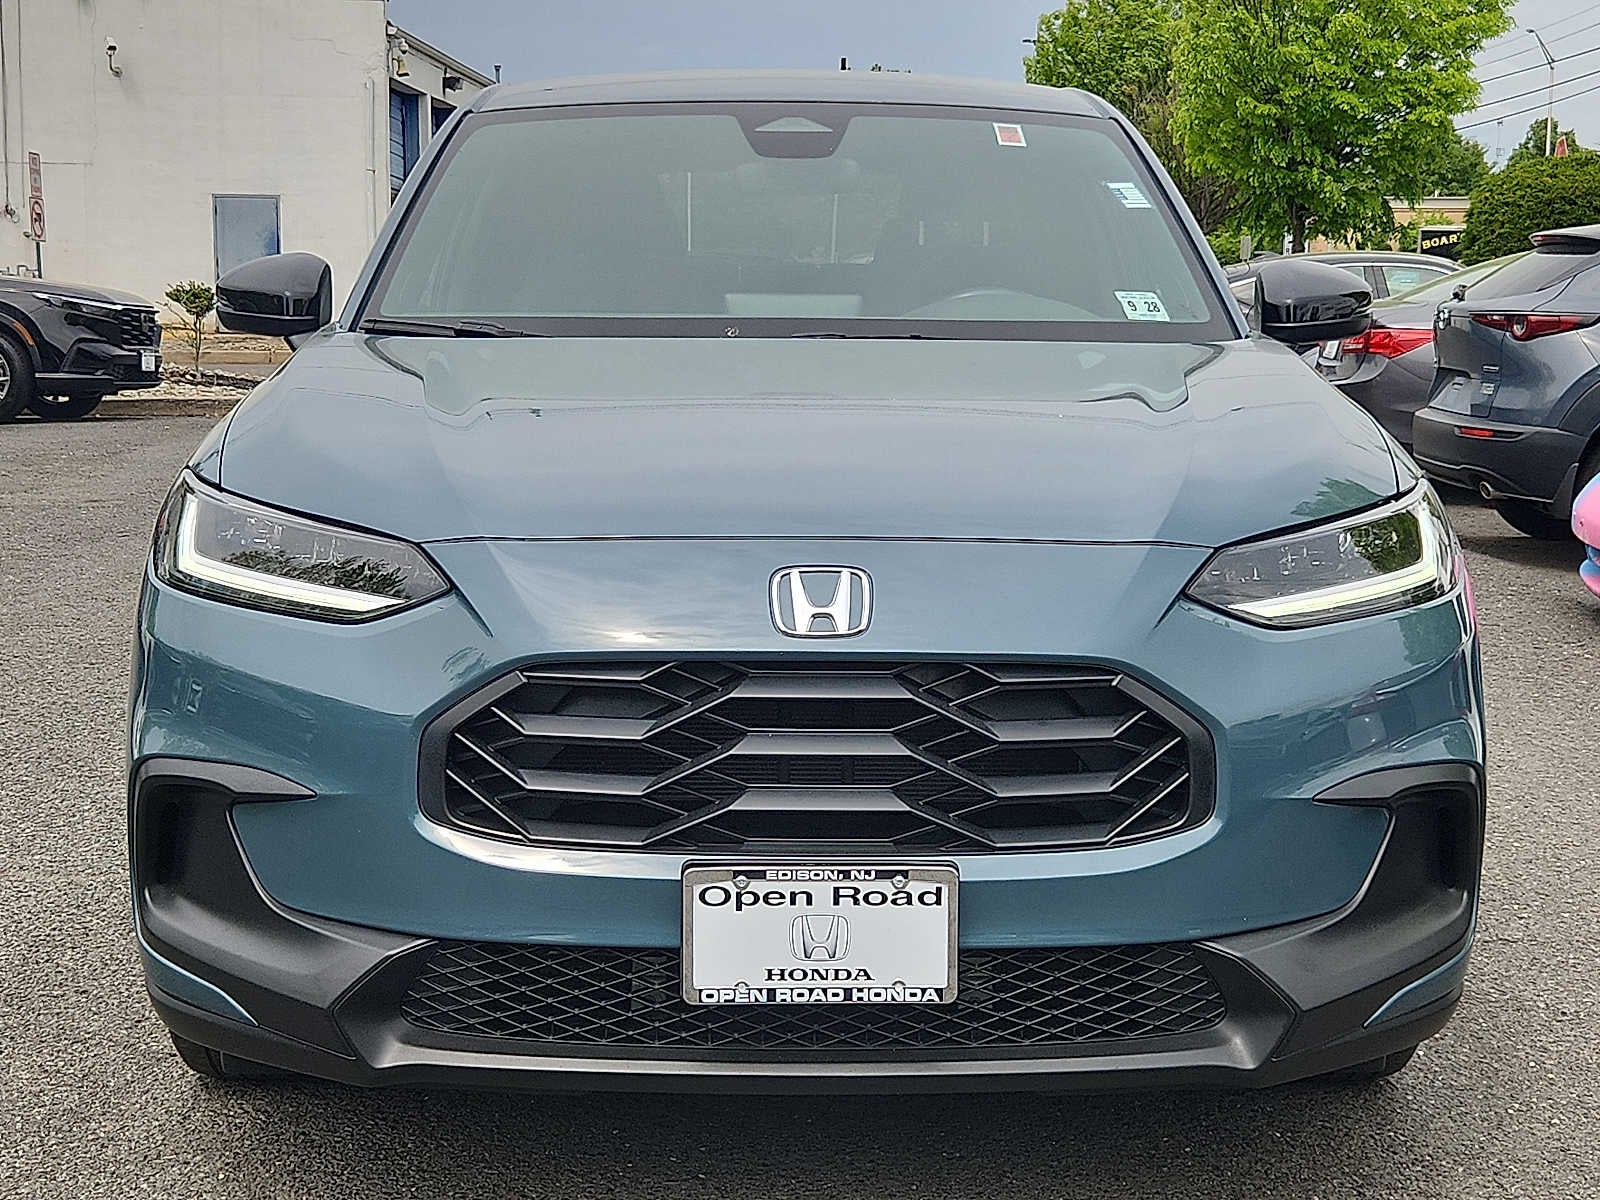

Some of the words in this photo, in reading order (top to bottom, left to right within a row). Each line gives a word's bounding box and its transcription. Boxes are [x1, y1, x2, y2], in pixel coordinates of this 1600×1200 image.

[1127, 300, 1137, 311] 9
[1144, 301, 1160, 312] 28
[765, 869, 844, 881] EDISON,
[850, 869, 876, 880] NJ
[699, 885, 813, 911] Open
[832, 886, 943, 907] Road
[764, 968, 875, 982] HONDA
[701, 988, 769, 1002] OPEN
[775, 988, 848, 1002] ROAD
[851, 988, 940, 1002] HONDA
